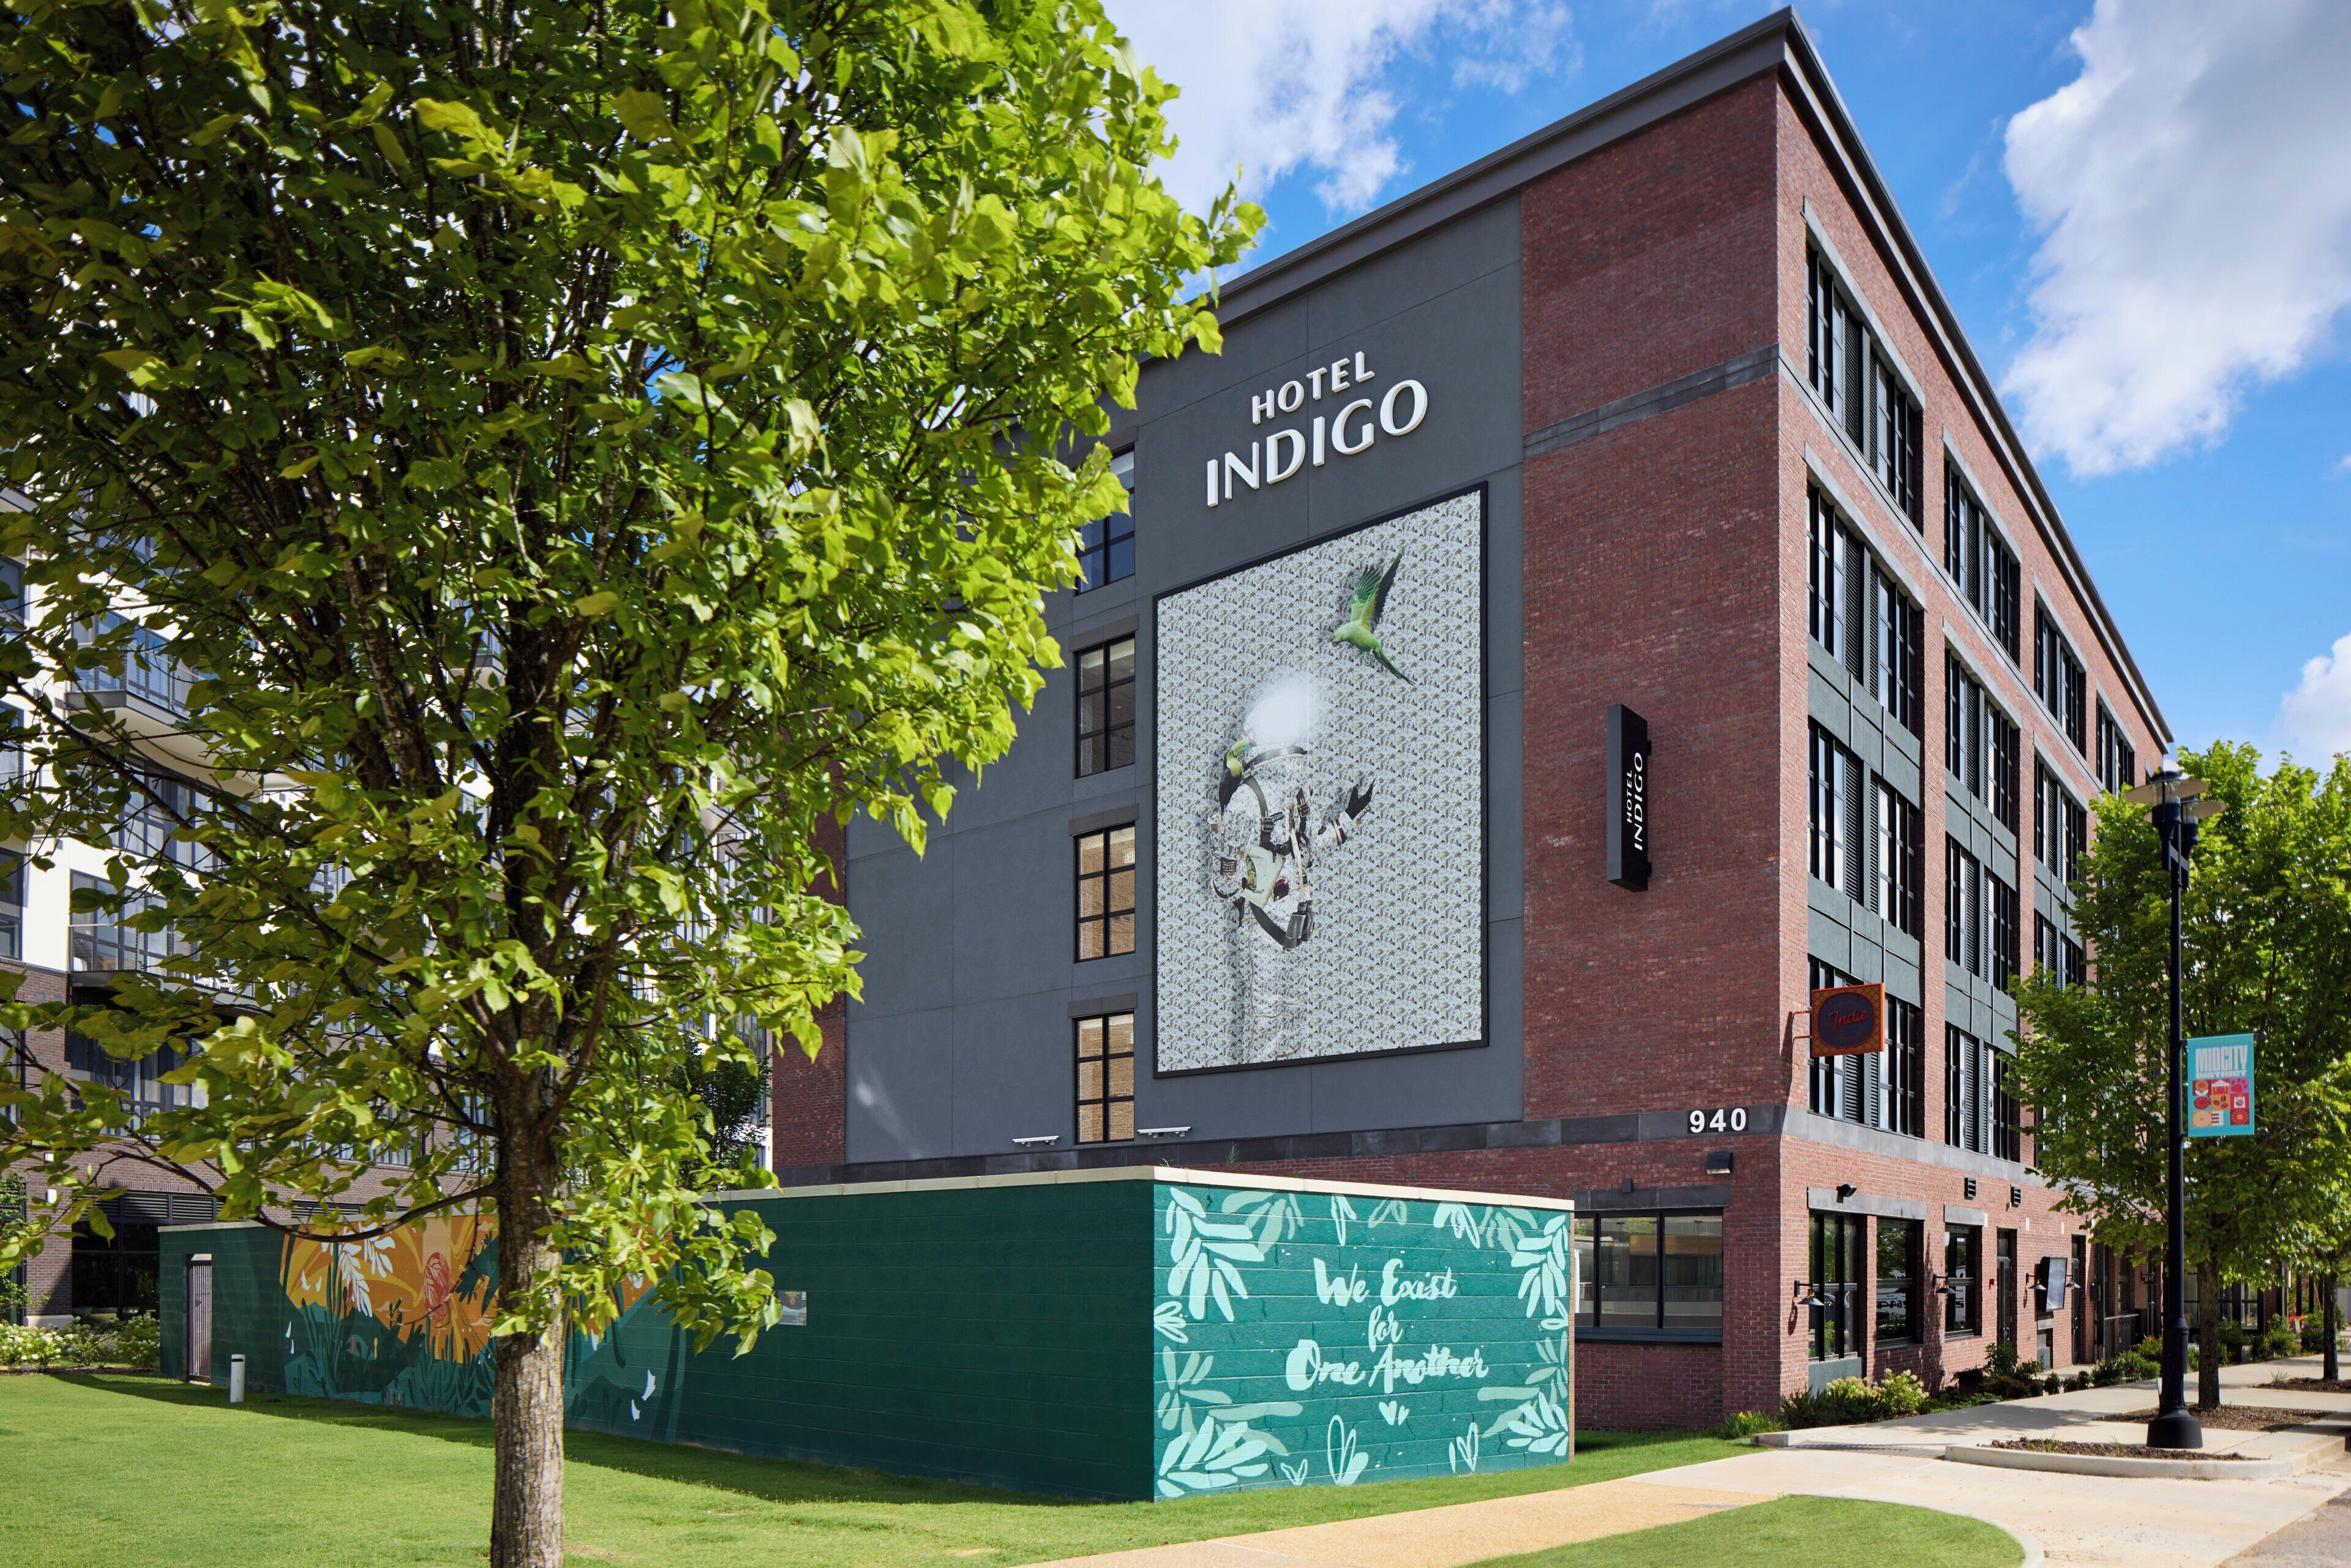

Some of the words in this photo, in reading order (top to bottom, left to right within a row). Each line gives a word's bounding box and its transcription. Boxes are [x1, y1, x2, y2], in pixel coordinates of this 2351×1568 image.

[1252, 351, 1375, 425] HOTEL
[1207, 380, 1428, 507] INDIGO
[1634, 752, 1643, 851] INDIGO
[1828, 1008, 1870, 1032] Indie
[2195, 1045, 2248, 1072] MIDCITY
[1690, 1108, 1746, 1133] 940
[1313, 1258, 1369, 1307] We
[1381, 1258, 1457, 1307] Exist
[1368, 1305, 1403, 1352] for
[1286, 1339, 1366, 1391] One
[1368, 1344, 1489, 1394] Another
